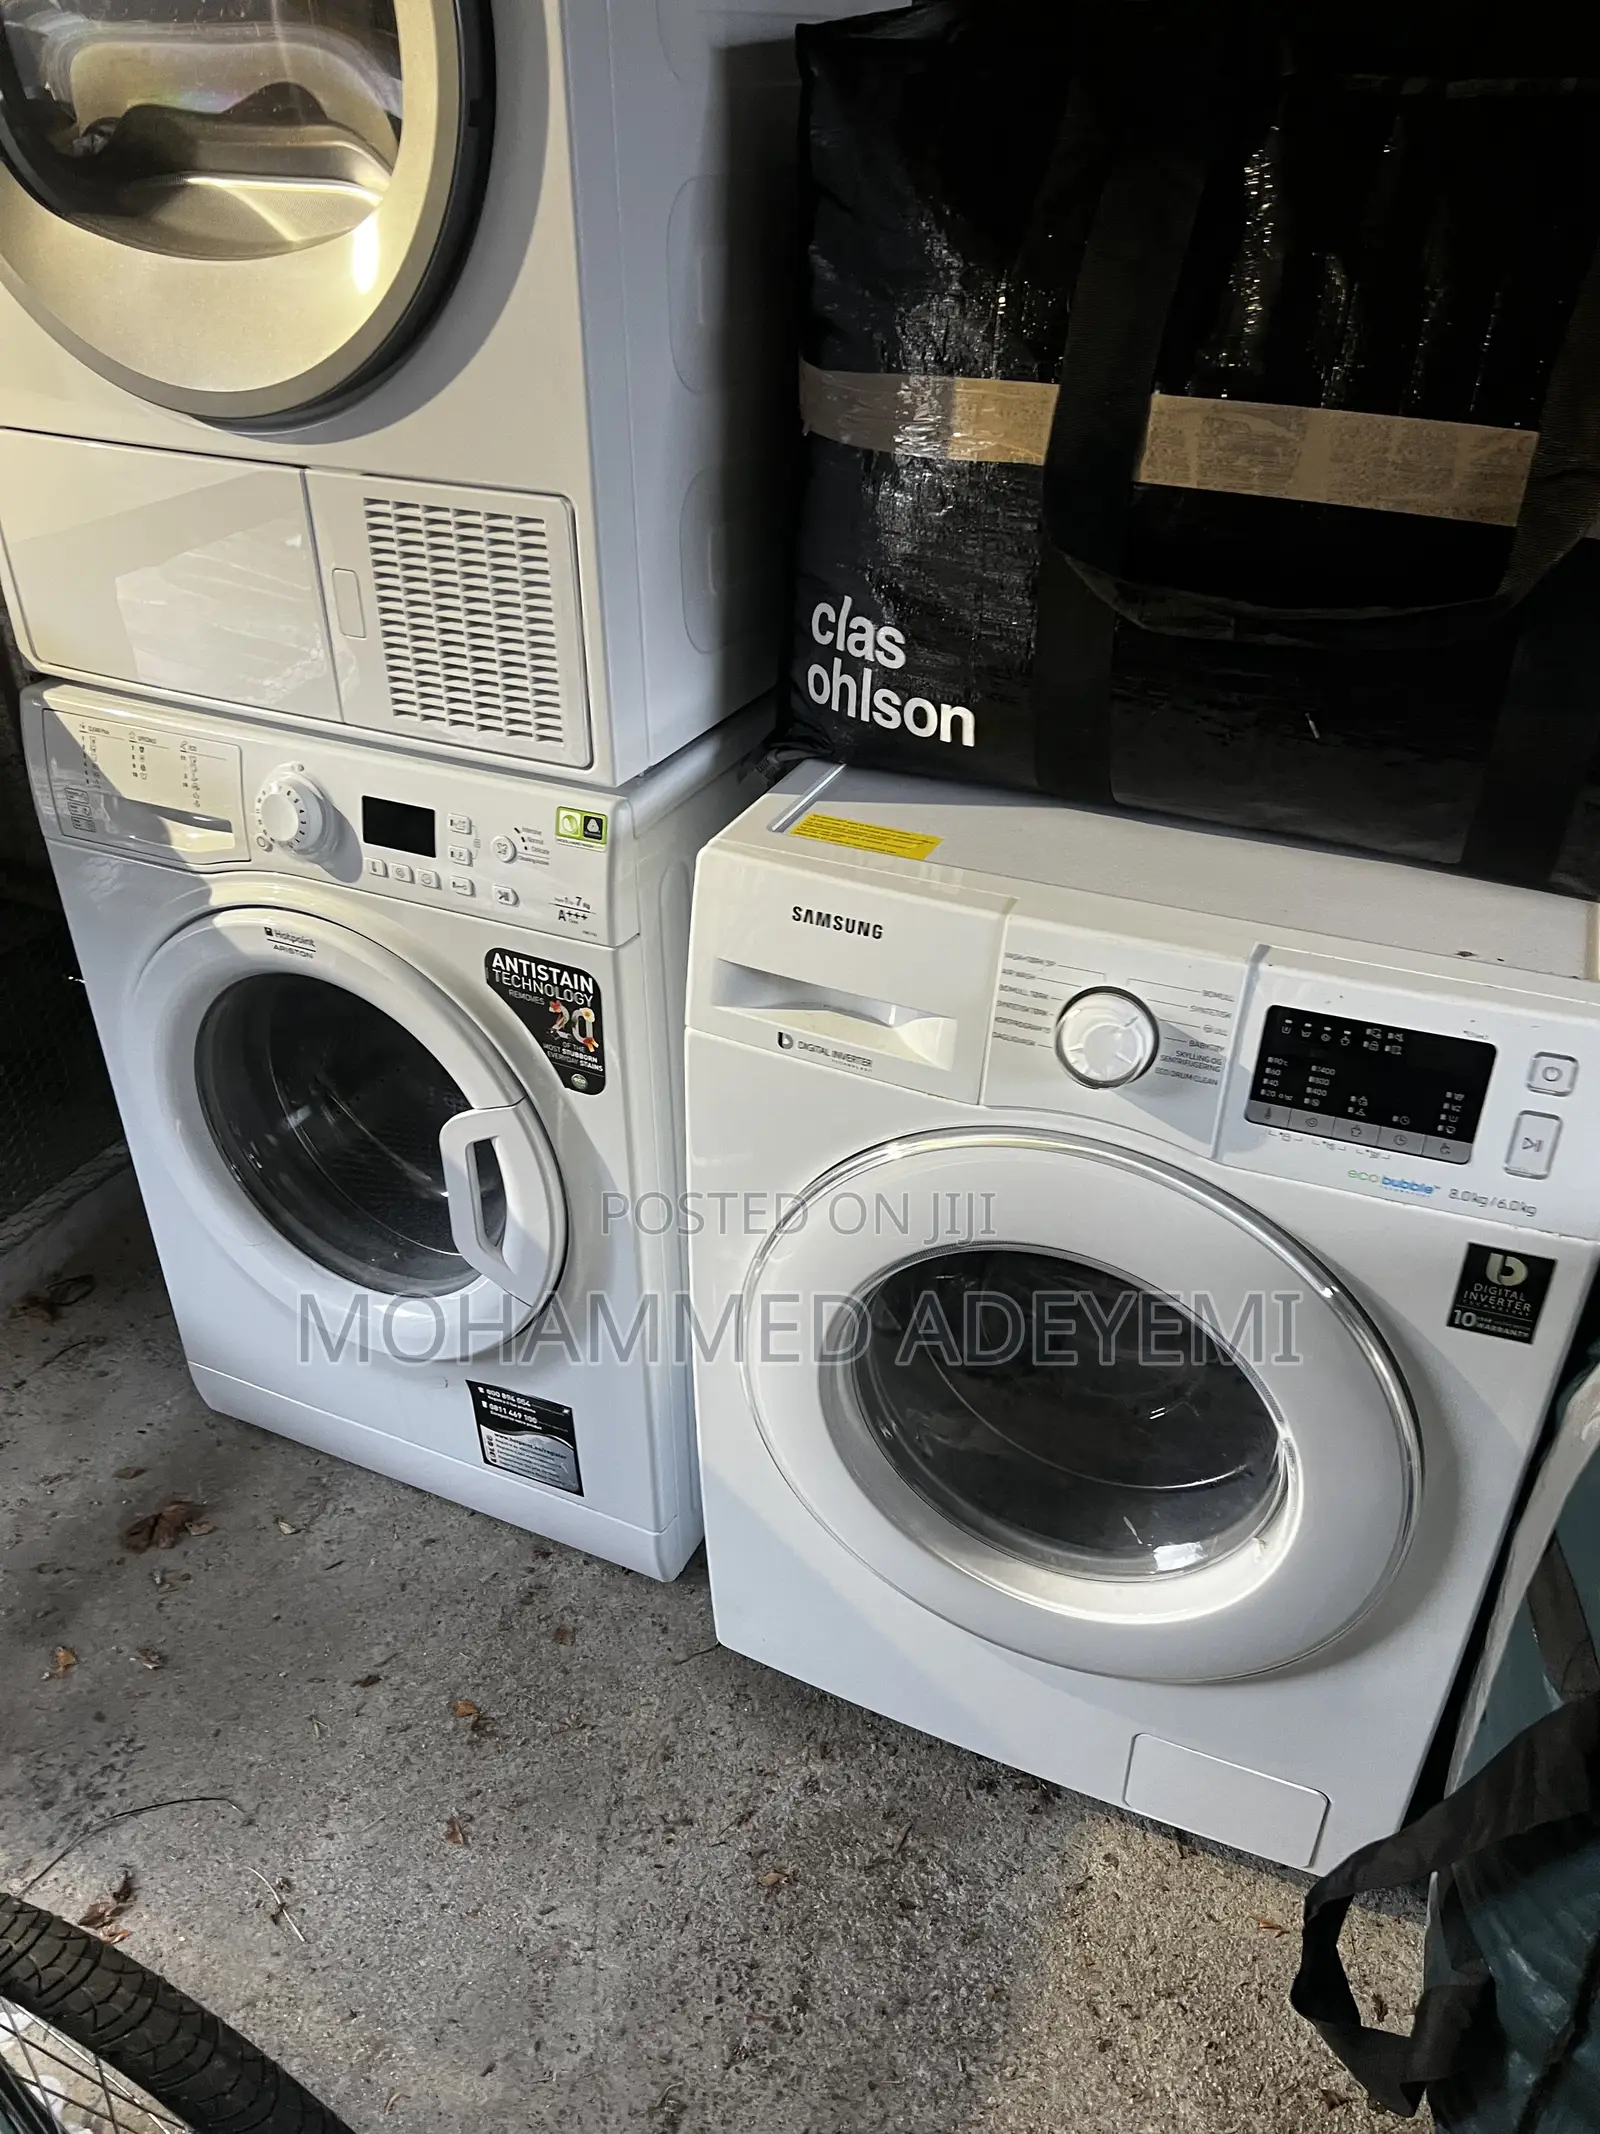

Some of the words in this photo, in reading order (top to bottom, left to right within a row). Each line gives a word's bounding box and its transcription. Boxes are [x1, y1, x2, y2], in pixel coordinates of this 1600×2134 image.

[811, 595, 906, 669] clas
[807, 657, 975, 747] ohlson
[792, 906, 883, 939] SAMSUNG
[274, 929, 316, 947] Hotpoint
[273, 944, 314, 958] ARISTON
[492, 952, 594, 994] ANTISTAIN
[492, 968, 594, 1008] TECHNOLOGY
[508, 988, 545, 1006] REMOVES
[562, 1048, 597, 1064] STUBBORN
[797, 1040, 830, 1057] DIGITAL
[831, 1050, 873, 1068] INVERTER
[1160, 1054, 1221, 1073] SENTRIFUGERING
[1176, 1050, 1210, 1063] SKYLLING
[1210, 1057, 1222, 1066] OG
[579, 1060, 603, 1072] STAINS
[1170, 1070, 1193, 1081] DRUM
[1194, 1075, 1218, 1086] CLEAN
[1348, 1169, 1379, 1183] eco
[1382, 1174, 1433, 1195] bubble
[1463, 1290, 1532, 1313] INVERTER
[1473, 1283, 1526, 1302] DIGITAL
[1454, 1309, 1477, 1328] 10
[1477, 1323, 1530, 1338] WARRANTY
[523, 1414, 538, 1424] 100
